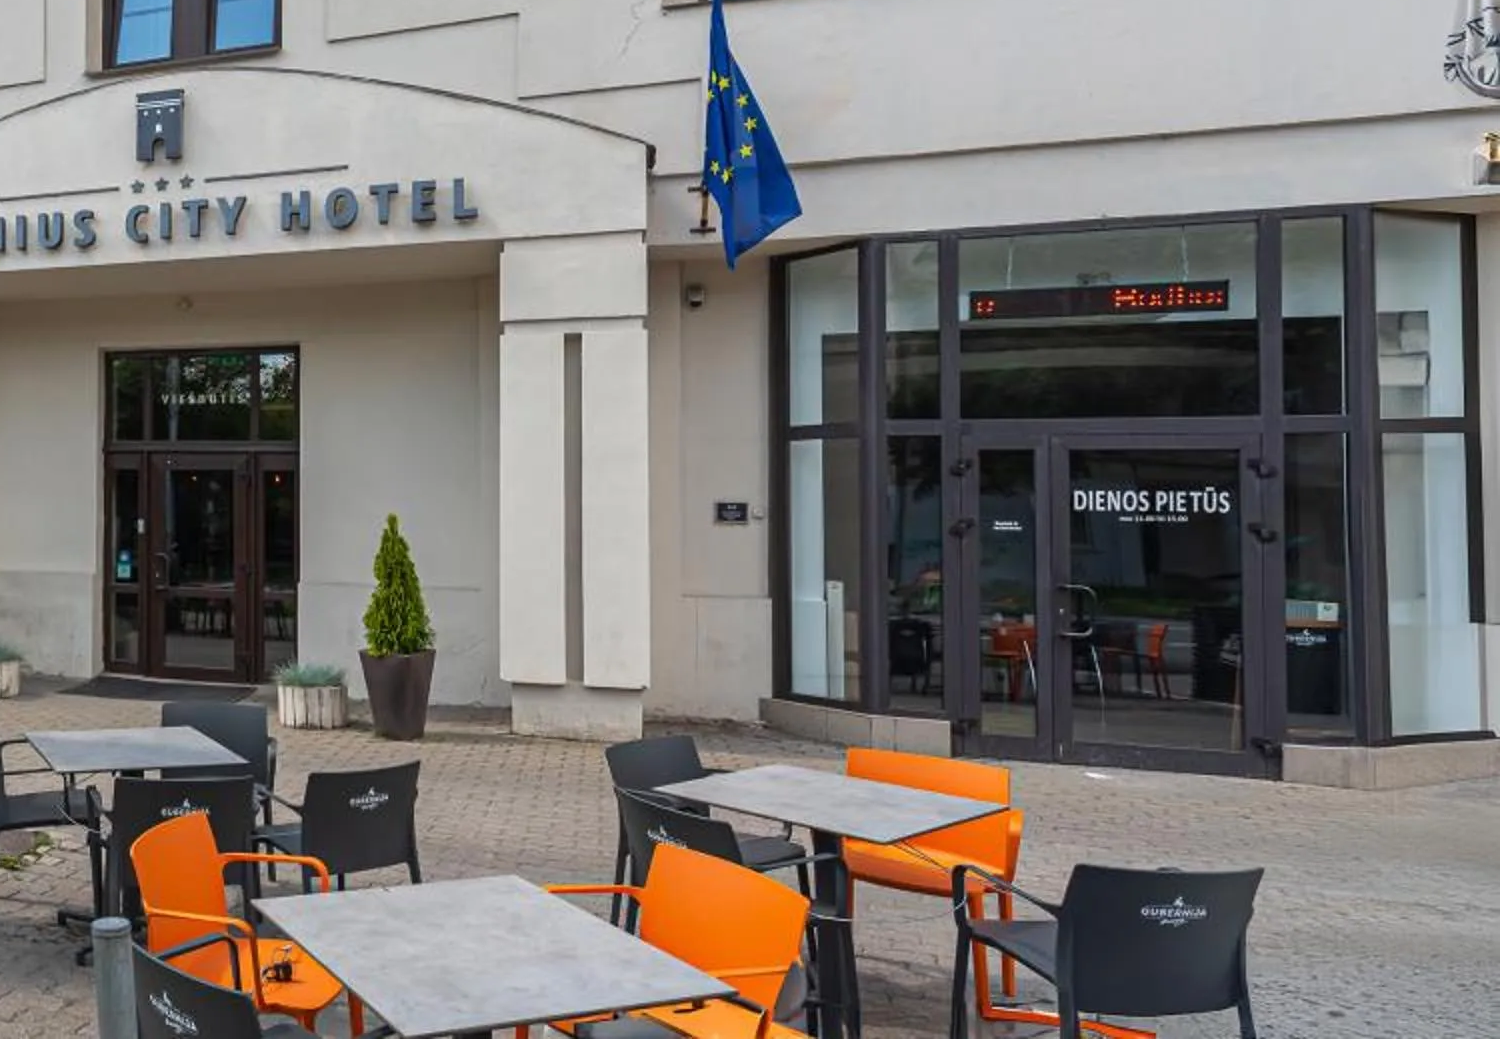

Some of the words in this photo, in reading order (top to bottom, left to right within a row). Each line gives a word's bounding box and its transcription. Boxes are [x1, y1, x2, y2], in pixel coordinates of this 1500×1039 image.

[124, 195, 248, 244] CITY
[280, 177, 480, 230] HOTEL
[1073, 489, 1150, 512] DIENOS
[1155, 486, 1231, 514] PIETŪS
